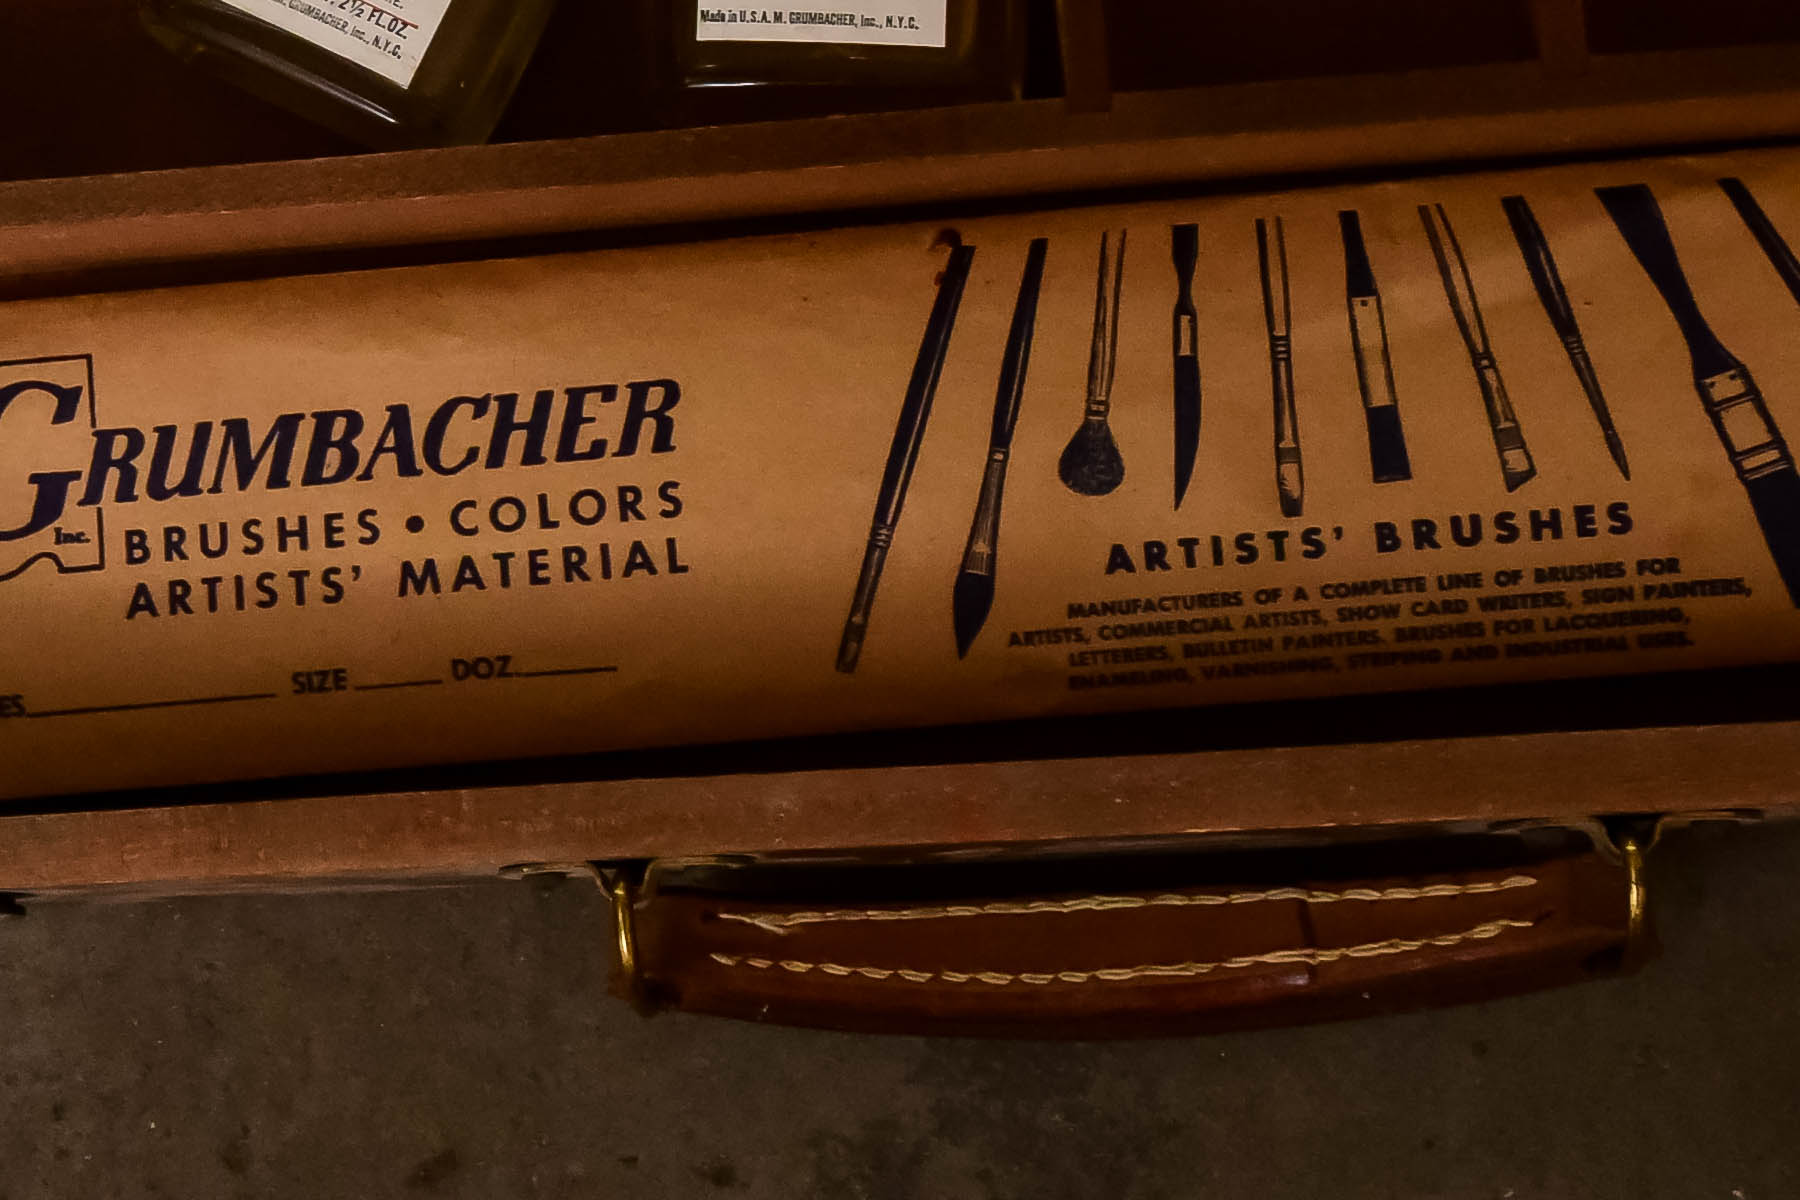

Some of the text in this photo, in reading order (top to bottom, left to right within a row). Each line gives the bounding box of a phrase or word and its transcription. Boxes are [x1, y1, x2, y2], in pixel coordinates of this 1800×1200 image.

[366, 6, 409, 40] FL.OZ.
[699, 9, 726, 24] Made
[727, 9, 738, 23] in
[788, 11, 859, 29] GRUMBACHER,
[885, 14, 920, 31] N.Y.C.
[370, 34, 403, 60] N.Y.C.
[53, 526, 92, 546] Inc.
[124, 480, 684, 567] BRUSHES COLORS
[1104, 501, 1634, 576] ARTISTS' BRUSHES
[124, 537, 690, 620] ARTISTS' MATERIAL
[1066, 556, 1681, 620] MANUFACTURERS OF A COMPLETE LINE OF BRUSHES FOR
[290, 667, 348, 696] SIZE
